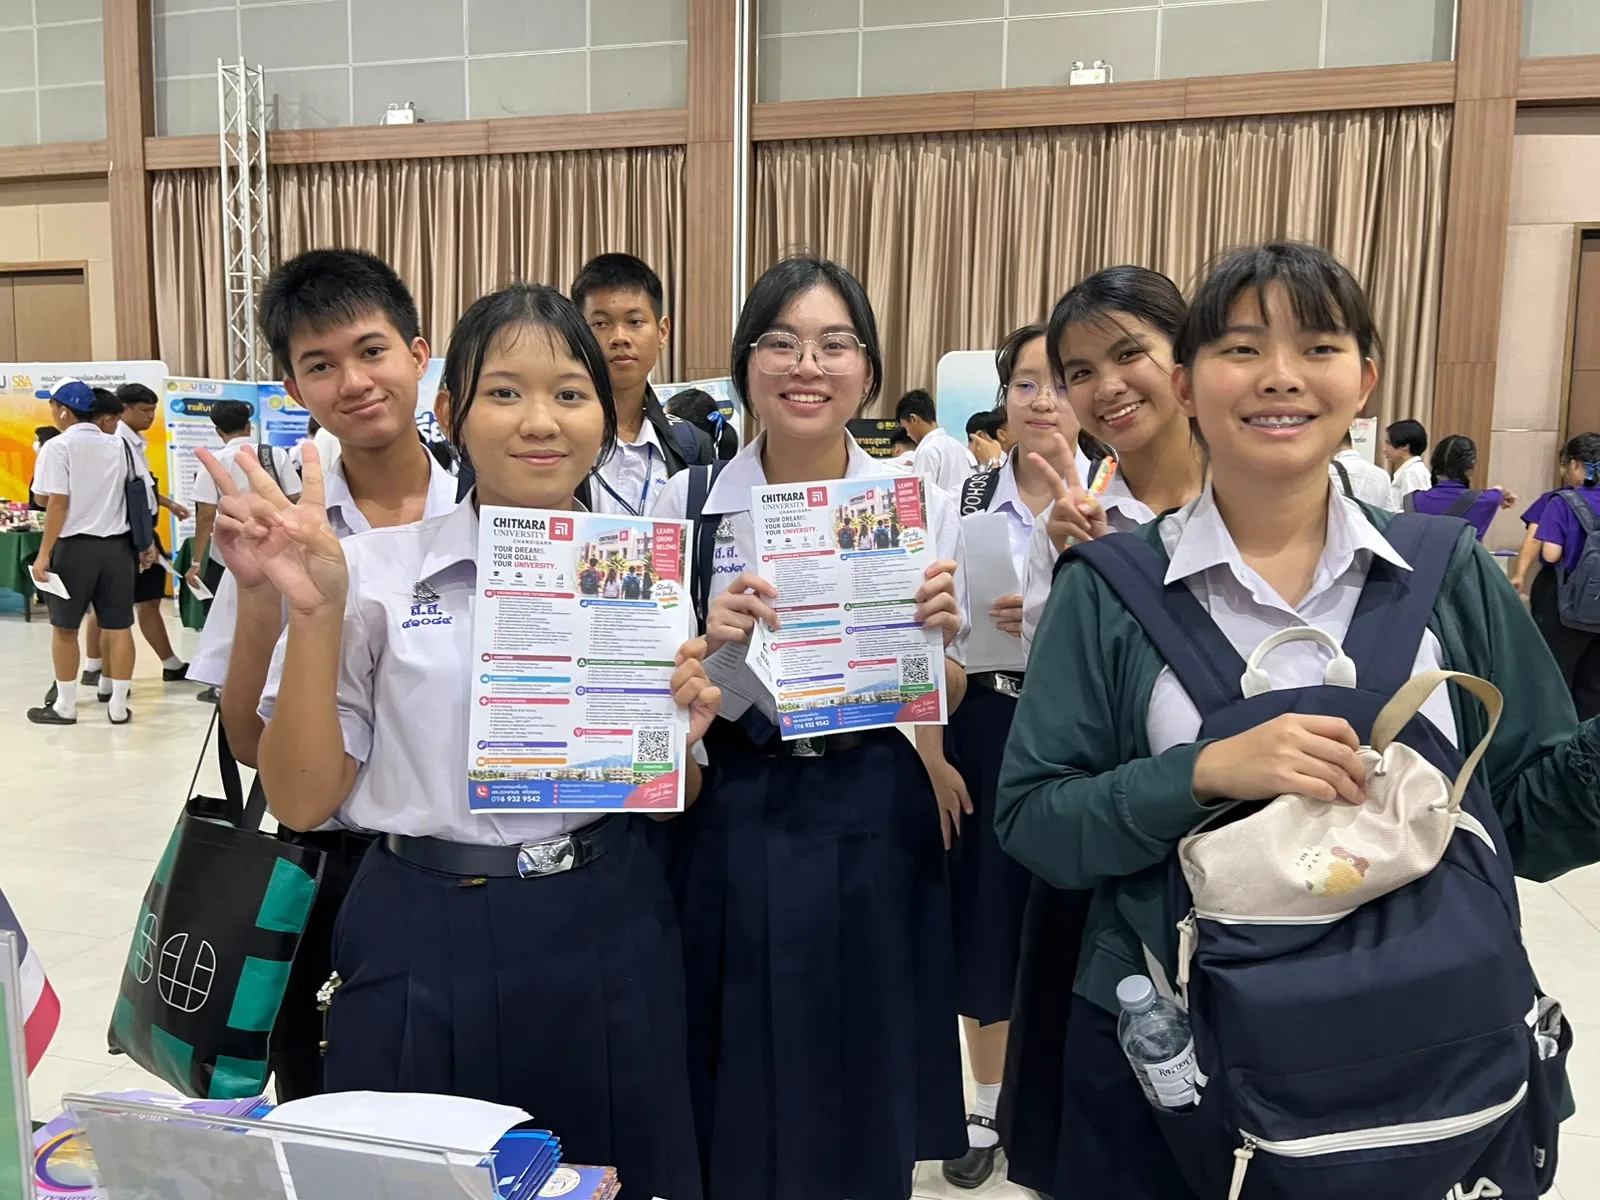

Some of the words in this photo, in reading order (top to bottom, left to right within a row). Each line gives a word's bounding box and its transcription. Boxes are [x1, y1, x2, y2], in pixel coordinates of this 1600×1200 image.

[761, 491, 805, 503] CHITKARA
[762, 502, 805, 511] UNIVERSITY
[493, 517, 546, 530] CHITKARA
[493, 528, 546, 539] UNIVERSITY
[493, 545, 513, 553] YOUR
[493, 560, 512, 568] YOUR
[514, 562, 558, 570] UNIVERSITY.
[656, 584, 674, 593] Study
[522, 795, 541, 803] 9542
